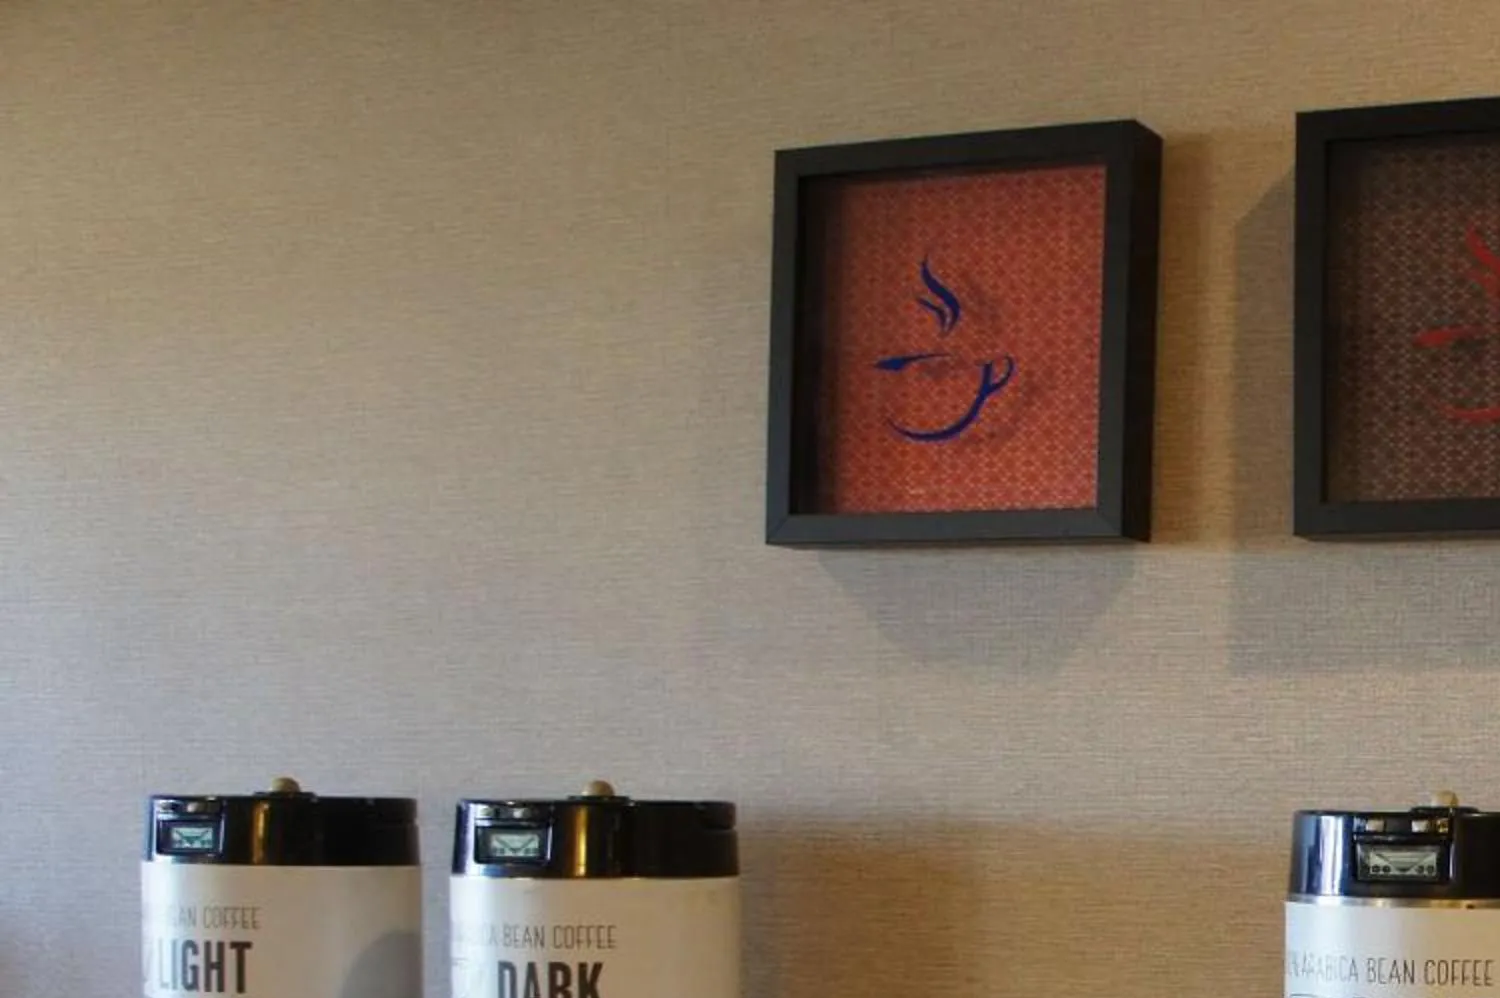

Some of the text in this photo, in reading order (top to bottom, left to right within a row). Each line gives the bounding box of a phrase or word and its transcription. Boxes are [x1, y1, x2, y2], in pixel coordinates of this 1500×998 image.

[203, 906, 262, 930] COFFEE
[503, 924, 545, 948] BEAN
[553, 925, 617, 949] COFFEE
[158, 938, 253, 993] LIGHT
[1367, 957, 1415, 985] BEAN
[1424, 959, 1494, 987] COFFEE
